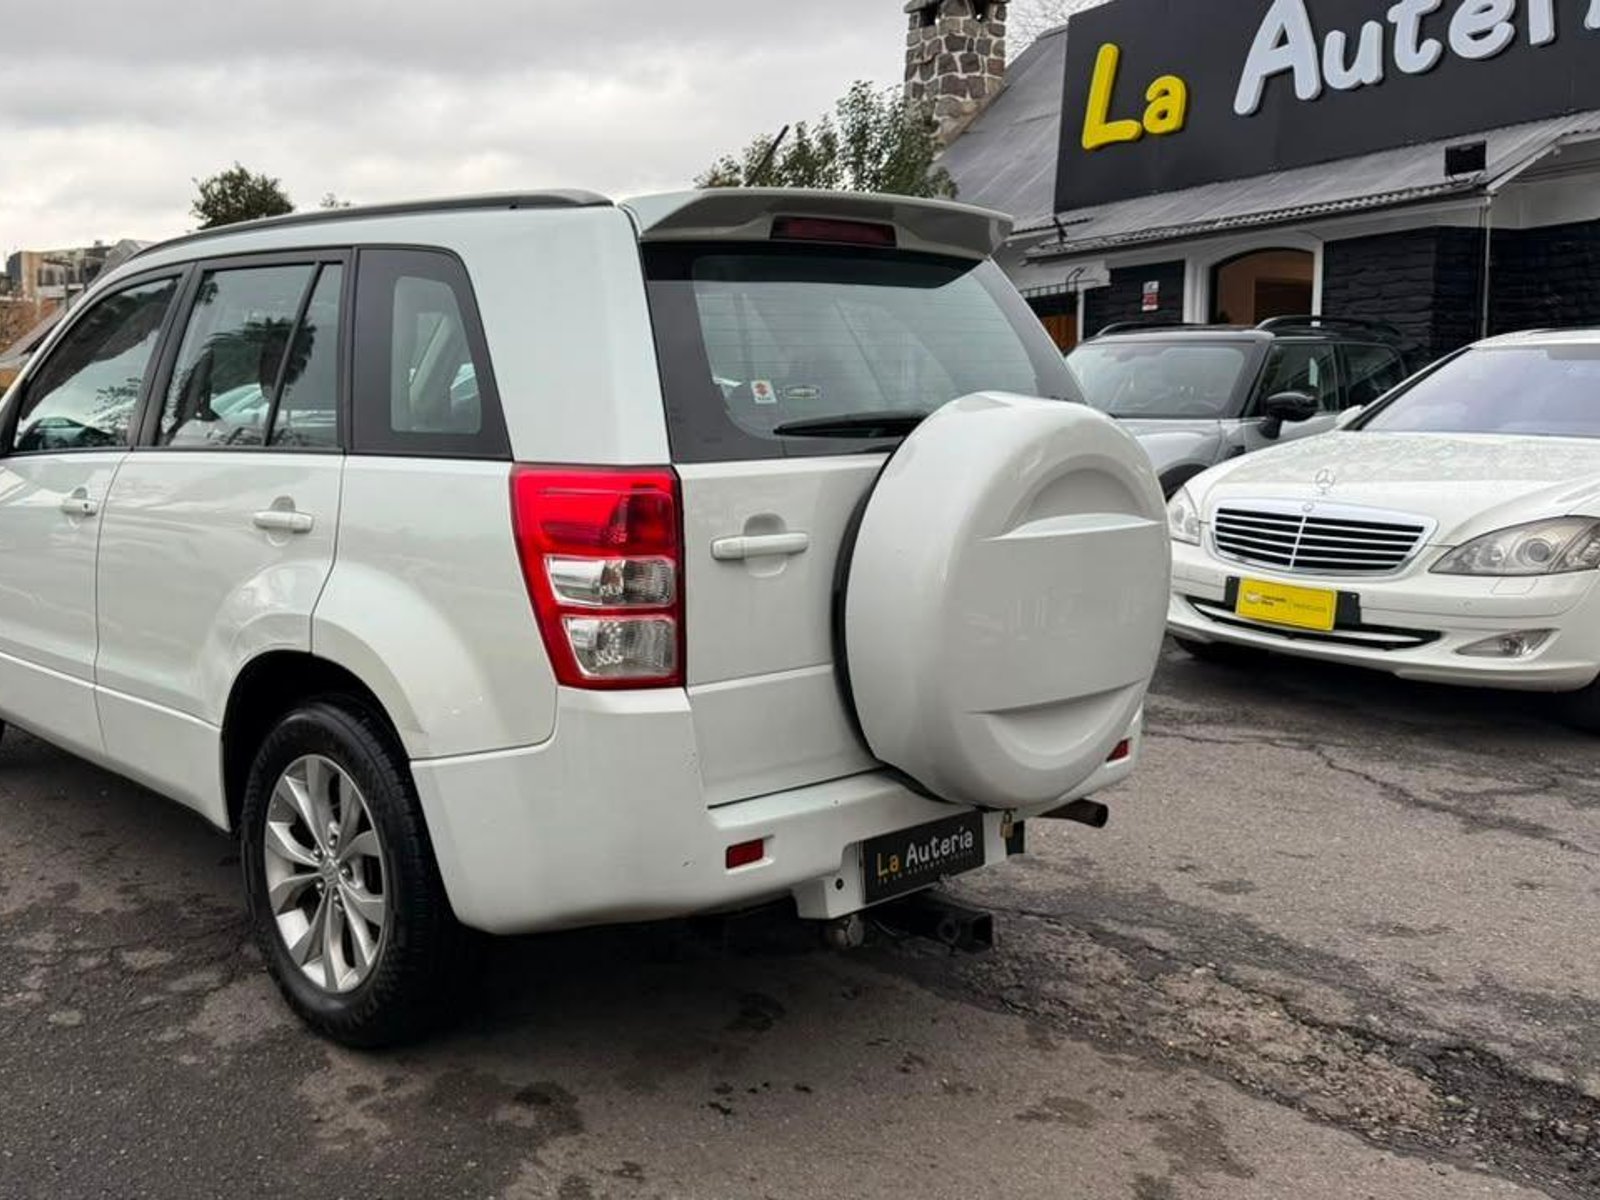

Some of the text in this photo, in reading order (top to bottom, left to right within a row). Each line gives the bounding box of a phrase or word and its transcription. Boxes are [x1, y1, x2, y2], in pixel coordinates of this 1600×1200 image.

[1081, 42, 1188, 151] La
[876, 852, 900, 877] La
[906, 825, 973, 868] Autería
